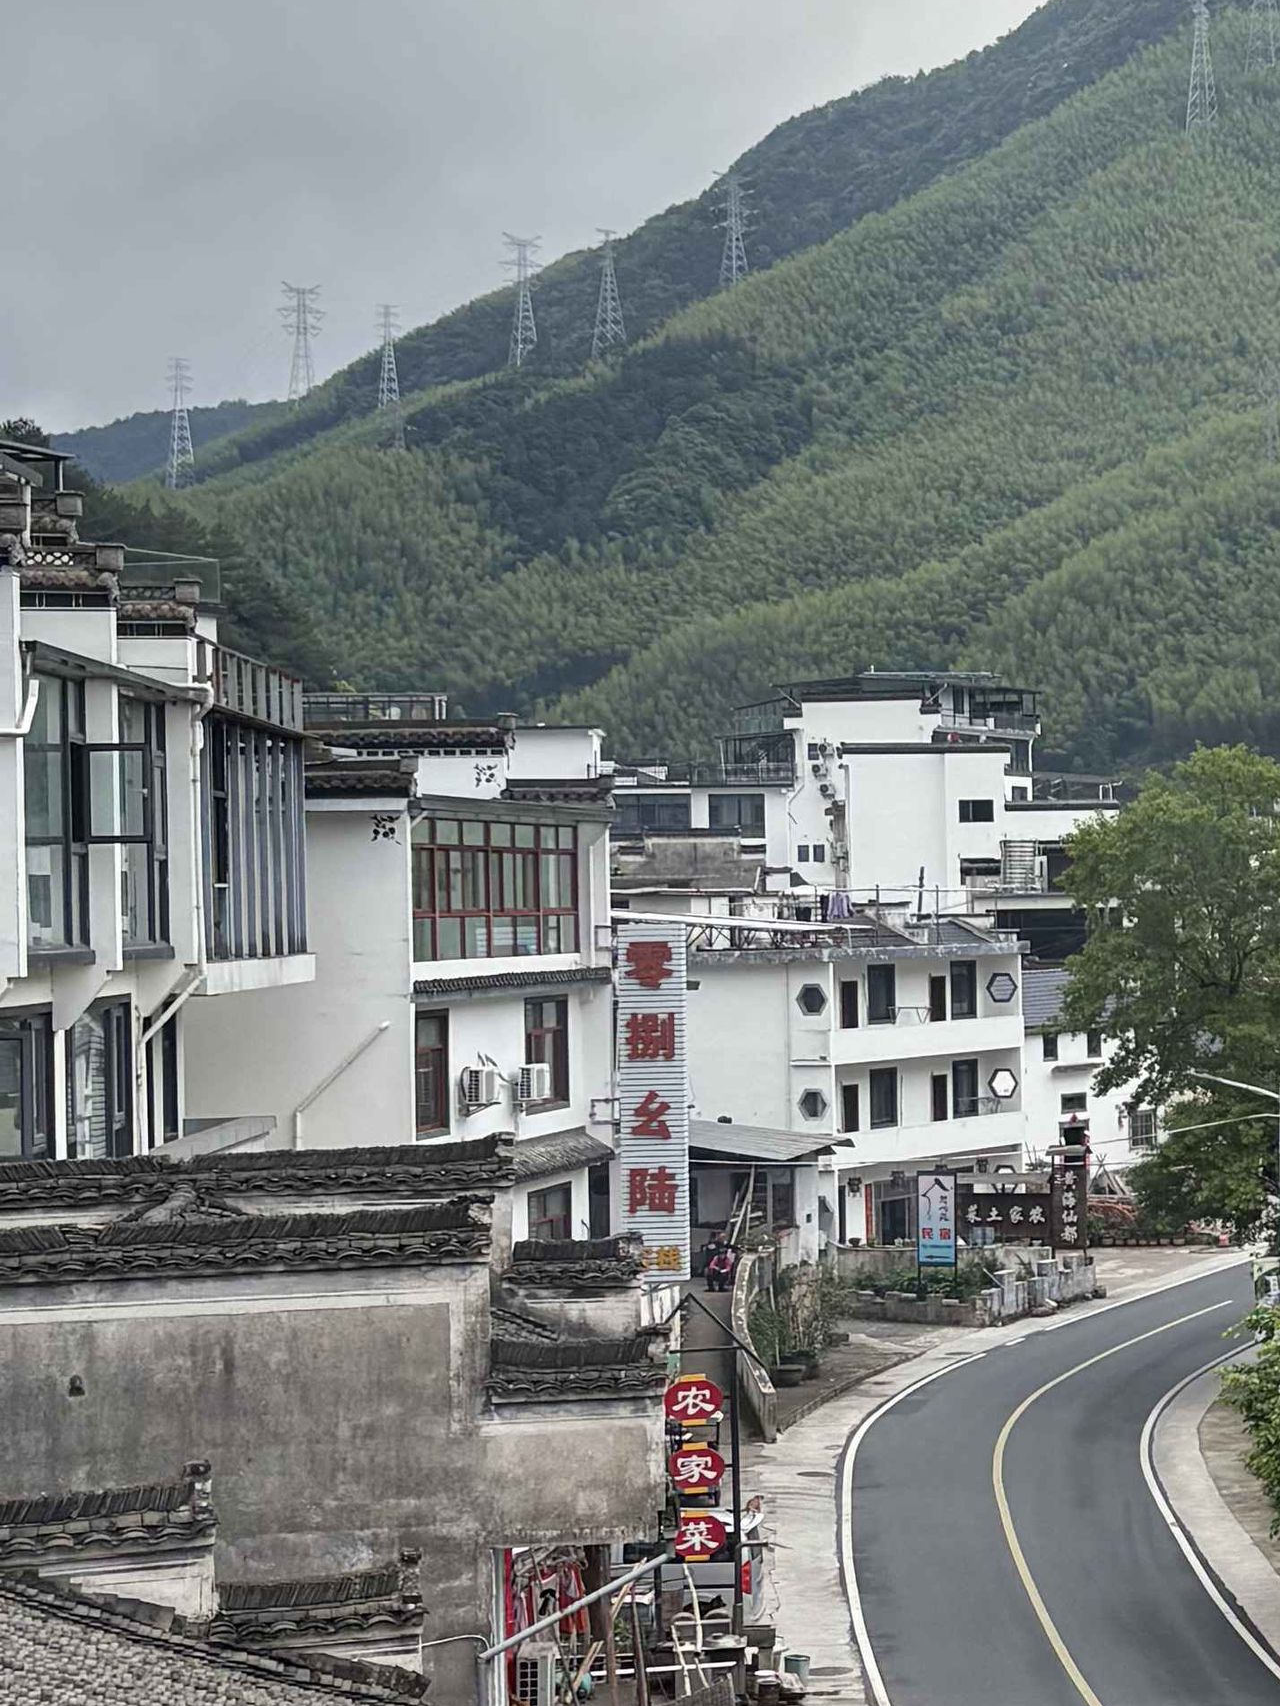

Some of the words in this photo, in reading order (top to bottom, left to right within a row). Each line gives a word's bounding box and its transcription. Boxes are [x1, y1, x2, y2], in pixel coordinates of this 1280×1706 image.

[625, 942, 679, 1214] 零捌幺陆
[672, 1386, 719, 1551] 农家菜
